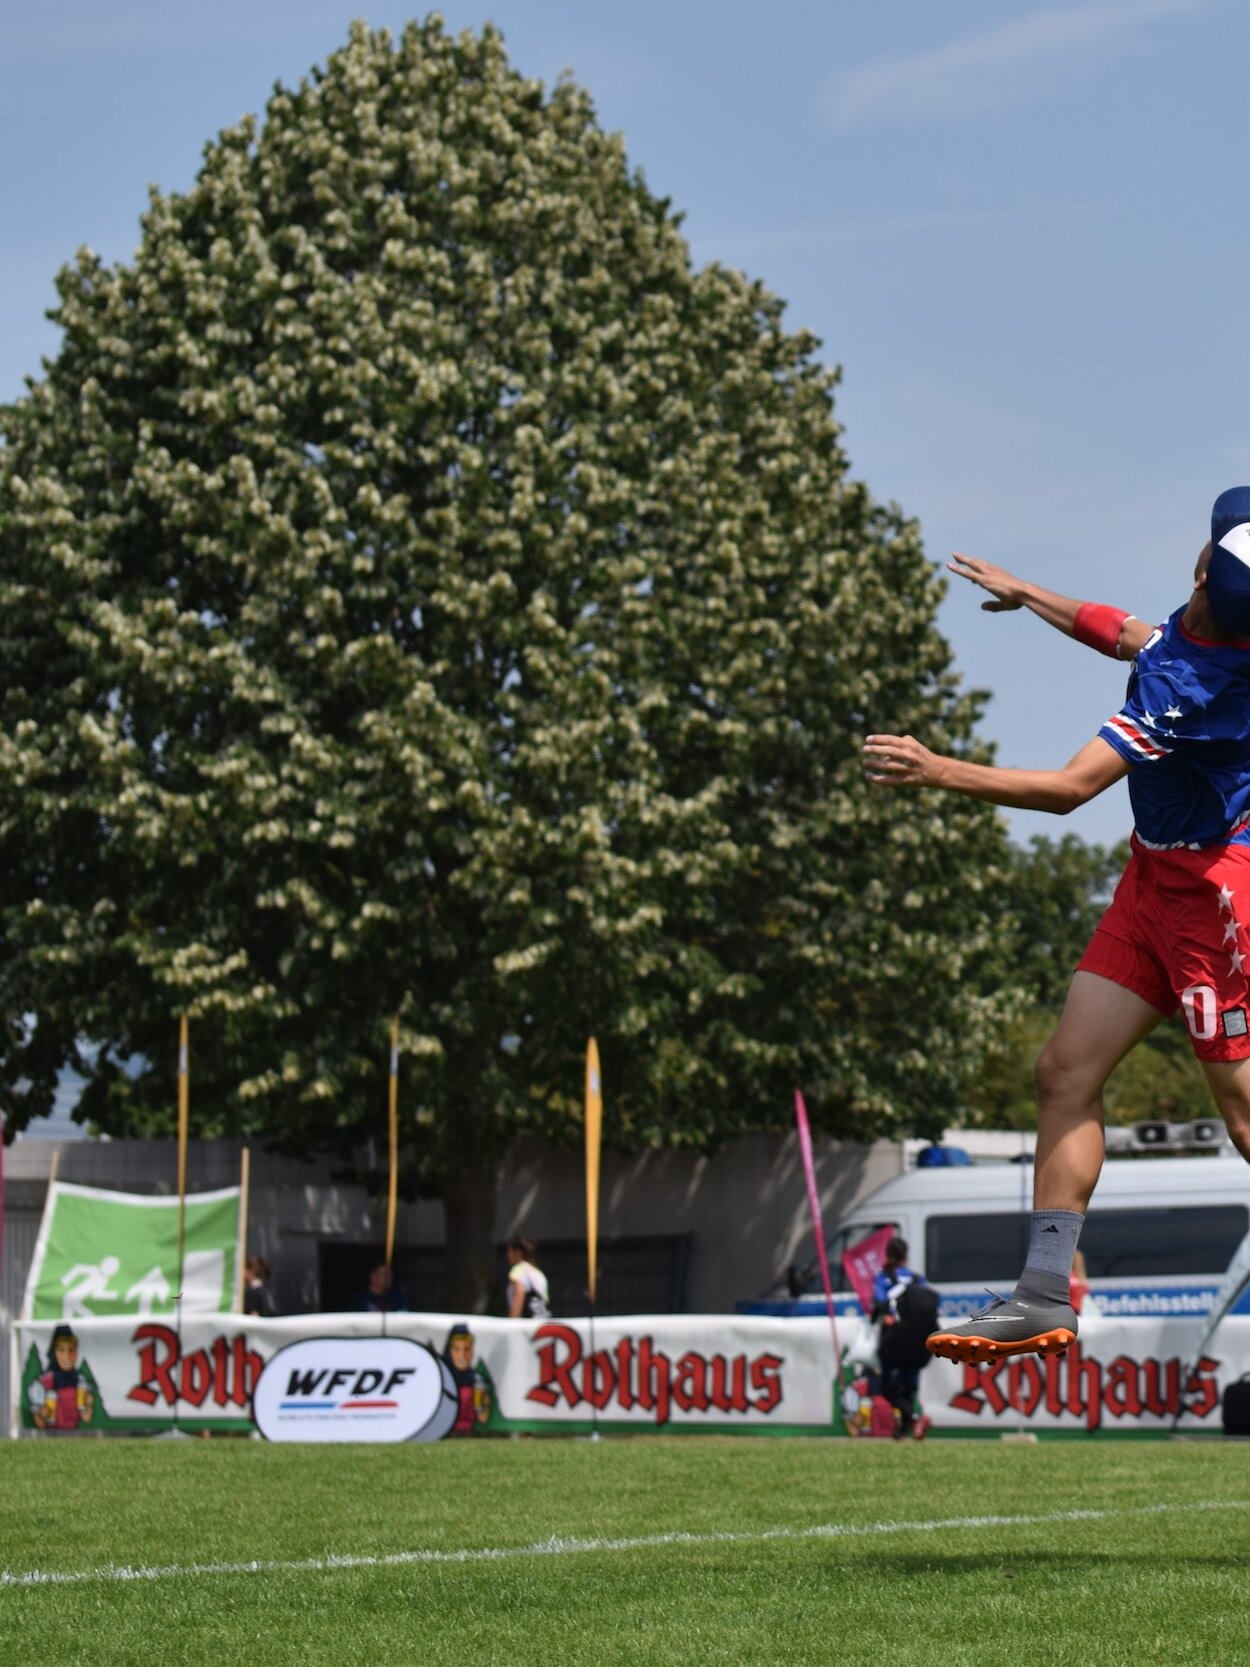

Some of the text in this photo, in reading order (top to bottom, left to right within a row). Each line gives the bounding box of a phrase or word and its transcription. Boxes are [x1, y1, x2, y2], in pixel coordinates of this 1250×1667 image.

[1096, 1292, 1214, 1317] Befehlsstell
[126, 1323, 264, 1408] Roth
[286, 1366, 417, 1397] WFDF
[525, 1321, 785, 1427] Rothaus
